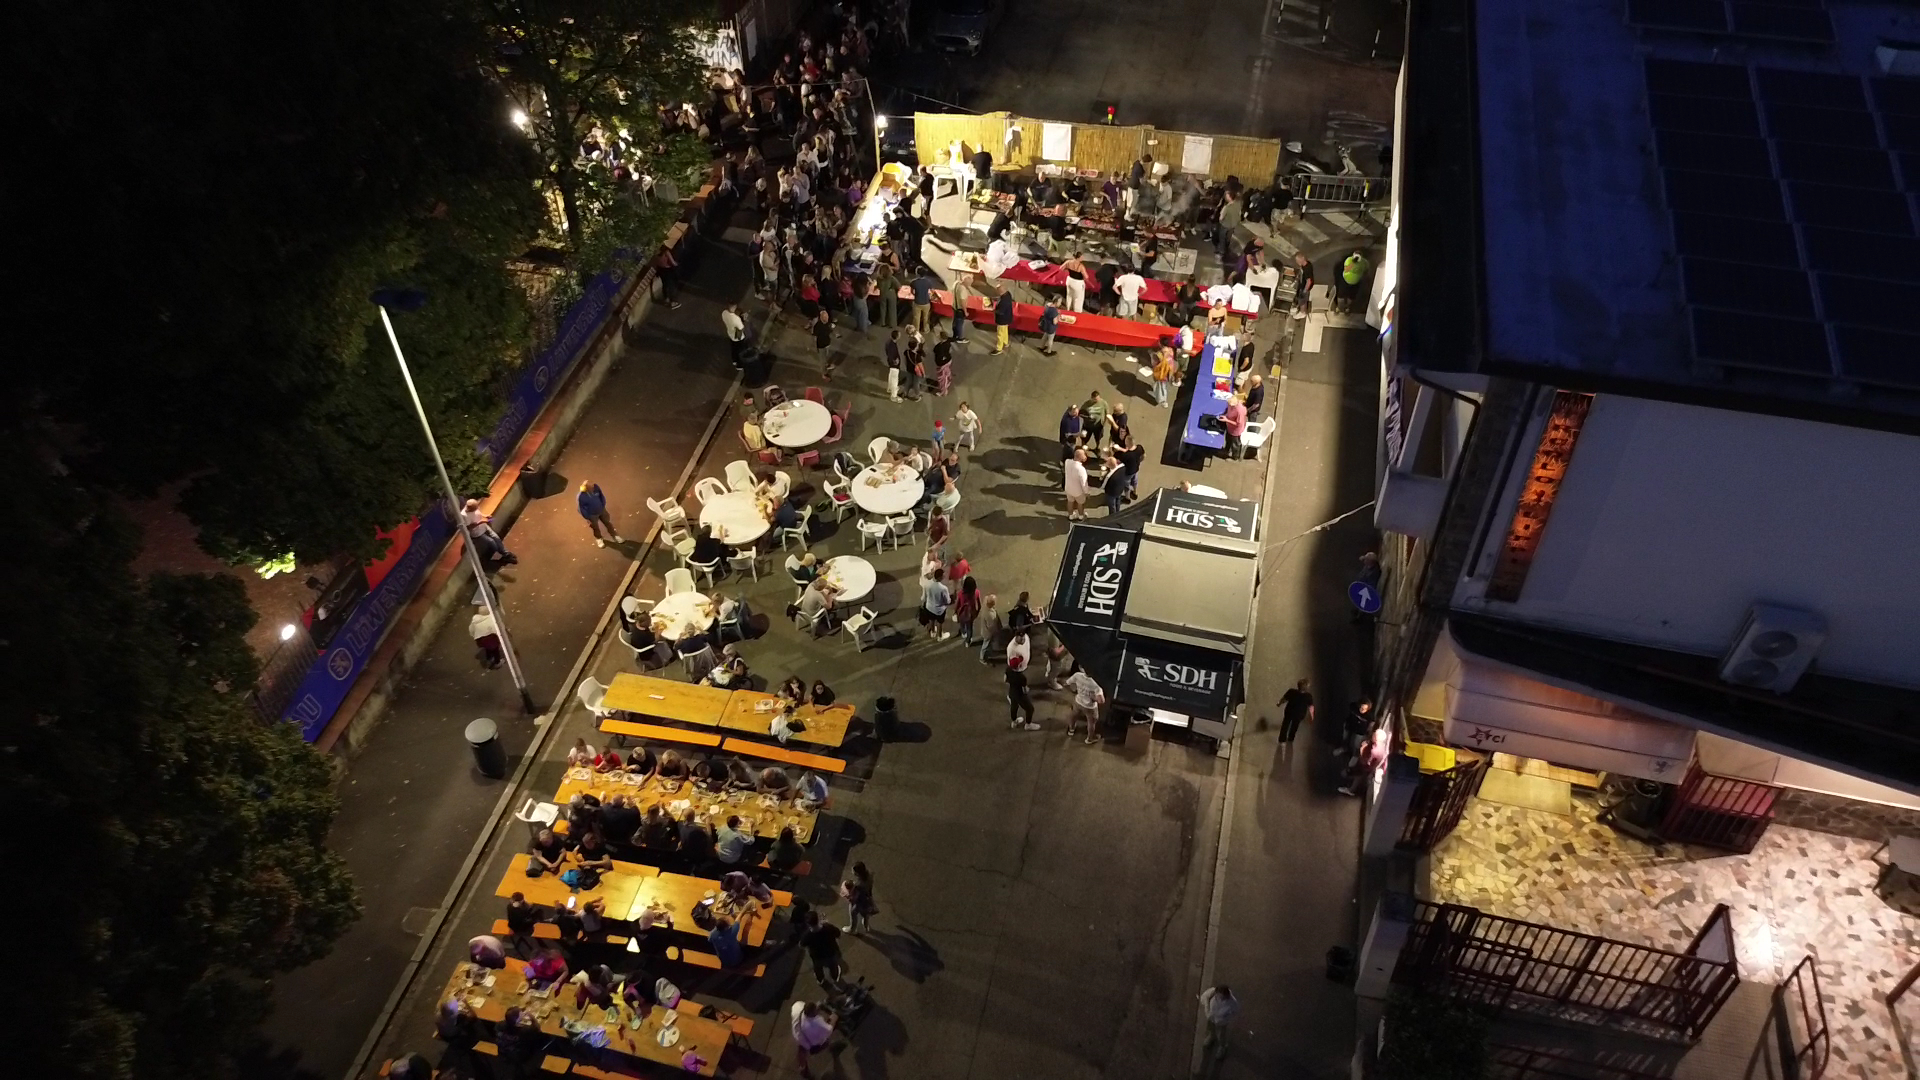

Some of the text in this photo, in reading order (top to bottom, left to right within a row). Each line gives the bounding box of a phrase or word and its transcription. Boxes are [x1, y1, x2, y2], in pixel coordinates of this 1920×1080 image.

[1165, 508, 1215, 529] SDH
[1084, 566, 1123, 616] SDH
[1163, 663, 1218, 690] SDH
